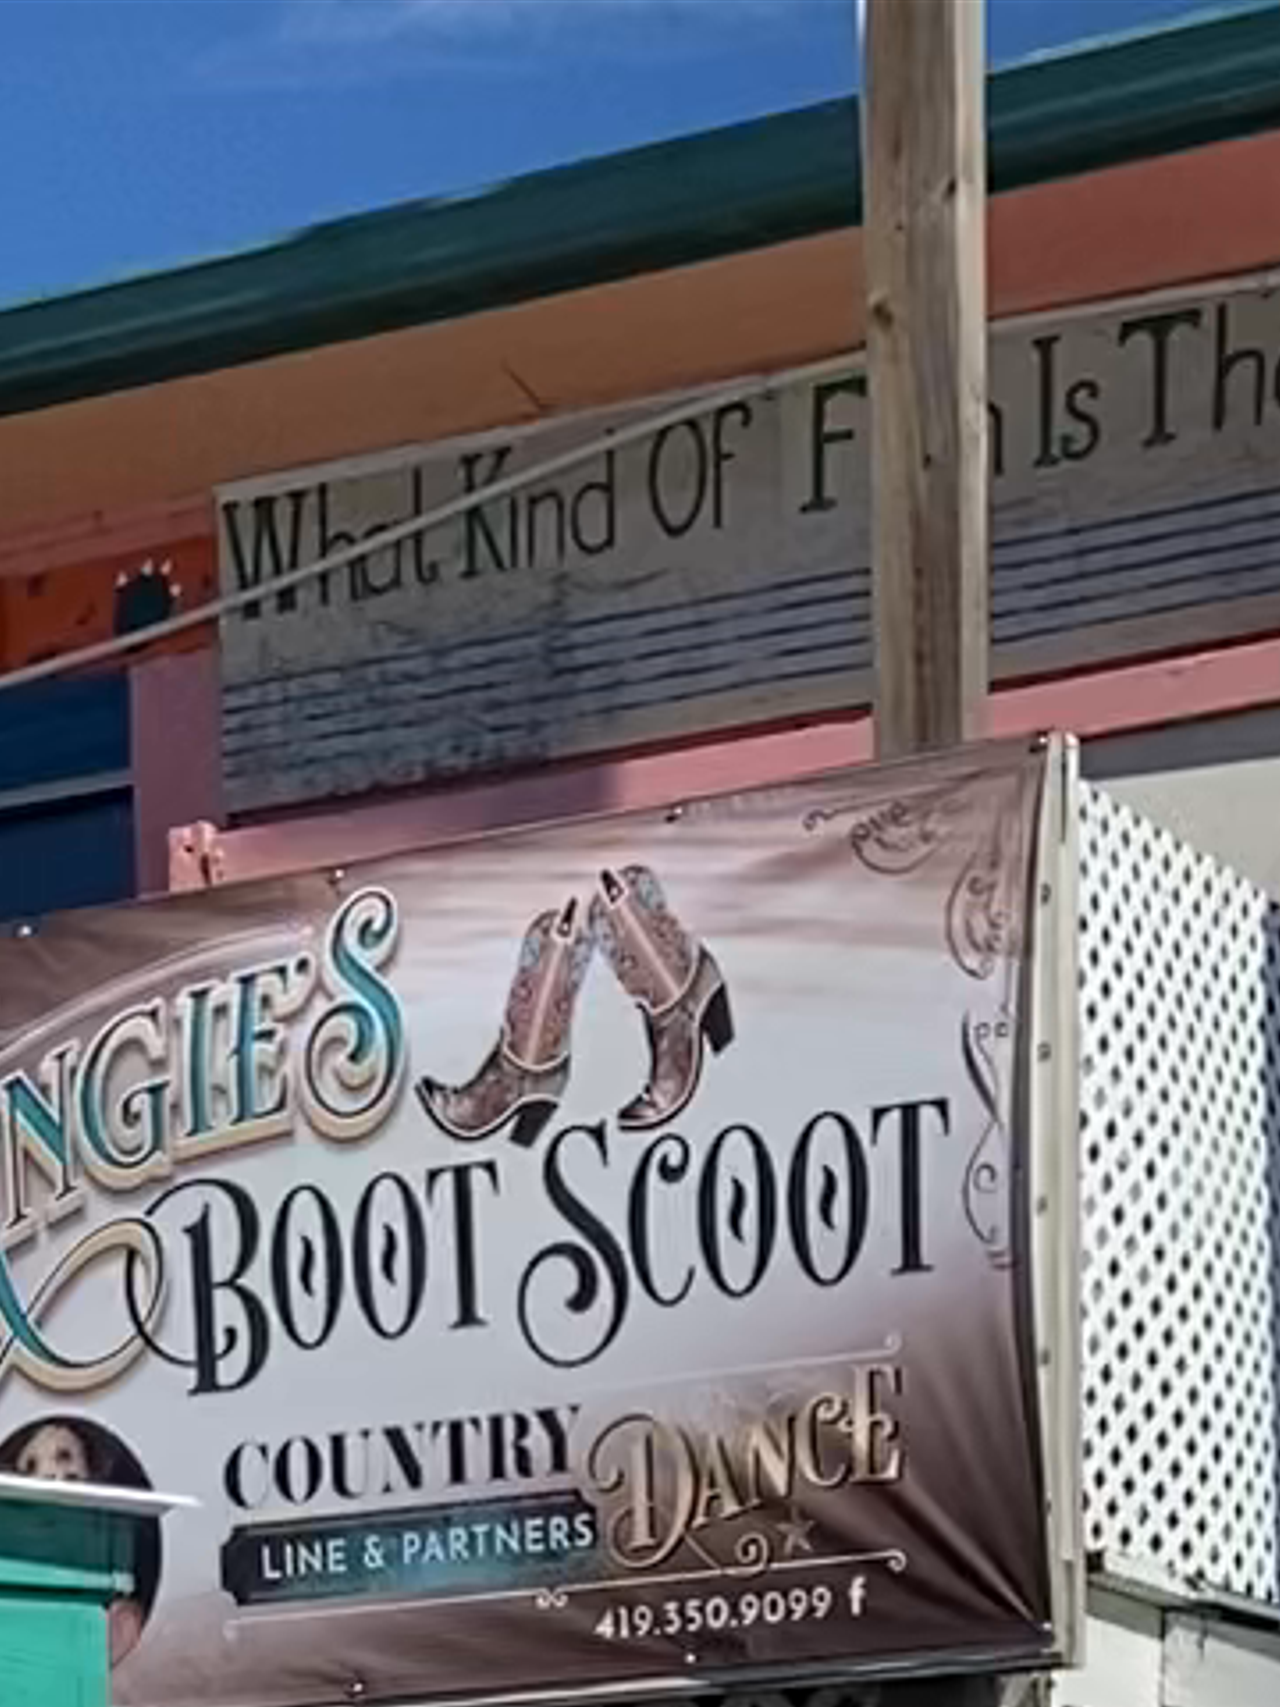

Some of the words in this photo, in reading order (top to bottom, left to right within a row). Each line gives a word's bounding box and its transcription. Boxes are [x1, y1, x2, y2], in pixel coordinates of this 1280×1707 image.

[222, 487, 441, 620] What
[456, 442, 617, 580] Kind
[798, 374, 1006, 515] Fn
[1031, 332, 1102, 468] Is
[120, 1158, 504, 1397] BOOT
[516, 1095, 950, 1369] SCOOT
[224, 1404, 581, 1511] COUNTRY
[586, 1356, 907, 1570] DANCE
[260, 1532, 347, 1582] LINE
[363, 1535, 387, 1570] &
[402, 1510, 596, 1565] PARTNERS
[593, 1586, 834, 1640] 419.350.9099
